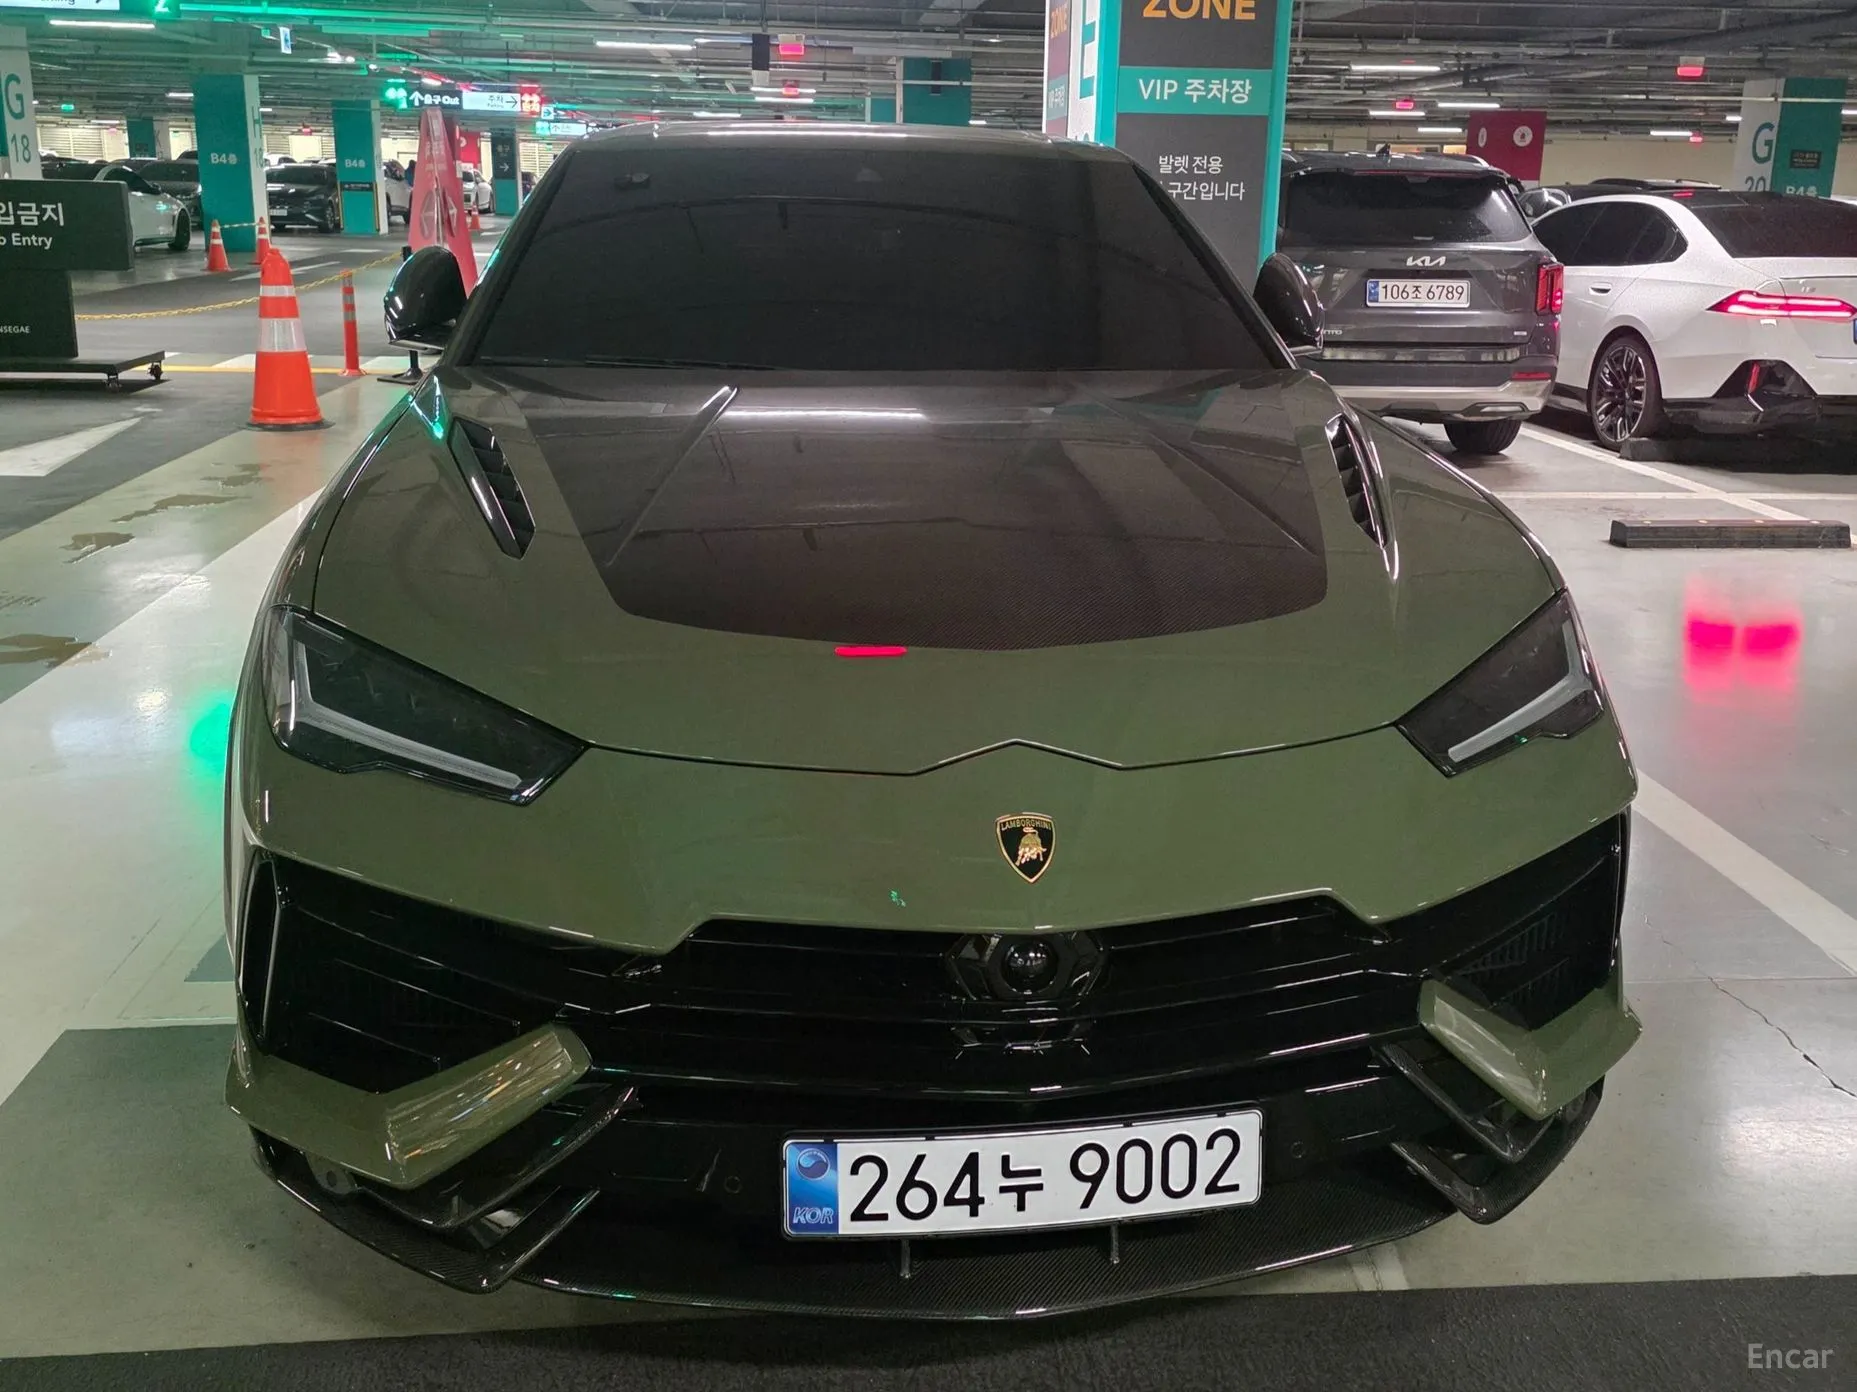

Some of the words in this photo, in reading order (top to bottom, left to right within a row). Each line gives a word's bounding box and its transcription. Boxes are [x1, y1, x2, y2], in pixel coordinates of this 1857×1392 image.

[1143, 0, 1256, 20] ZONE
[4, 73, 25, 120] G
[1139, 79, 1178, 100] VIP
[1184, 78, 1252, 104] 주차장
[10, 133, 31, 163] 18
[1752, 122, 1775, 164] G
[1158, 155, 1189, 174] 발렛
[1192, 156, 1223, 175] 전용
[1167, 182, 1245, 201] 구간입니다
[12, 233, 53, 249] Entry
[1406, 256, 1446, 267] KIA
[1382, 284, 1422, 300] 106조
[1426, 284, 1464, 301] 6789
[1001, 819, 1051, 831] LAMBORGHINI
[850, 1151, 1044, 1222] 264누
[1069, 1128, 1241, 1210] 9002
[793, 1206, 834, 1224] KOR
